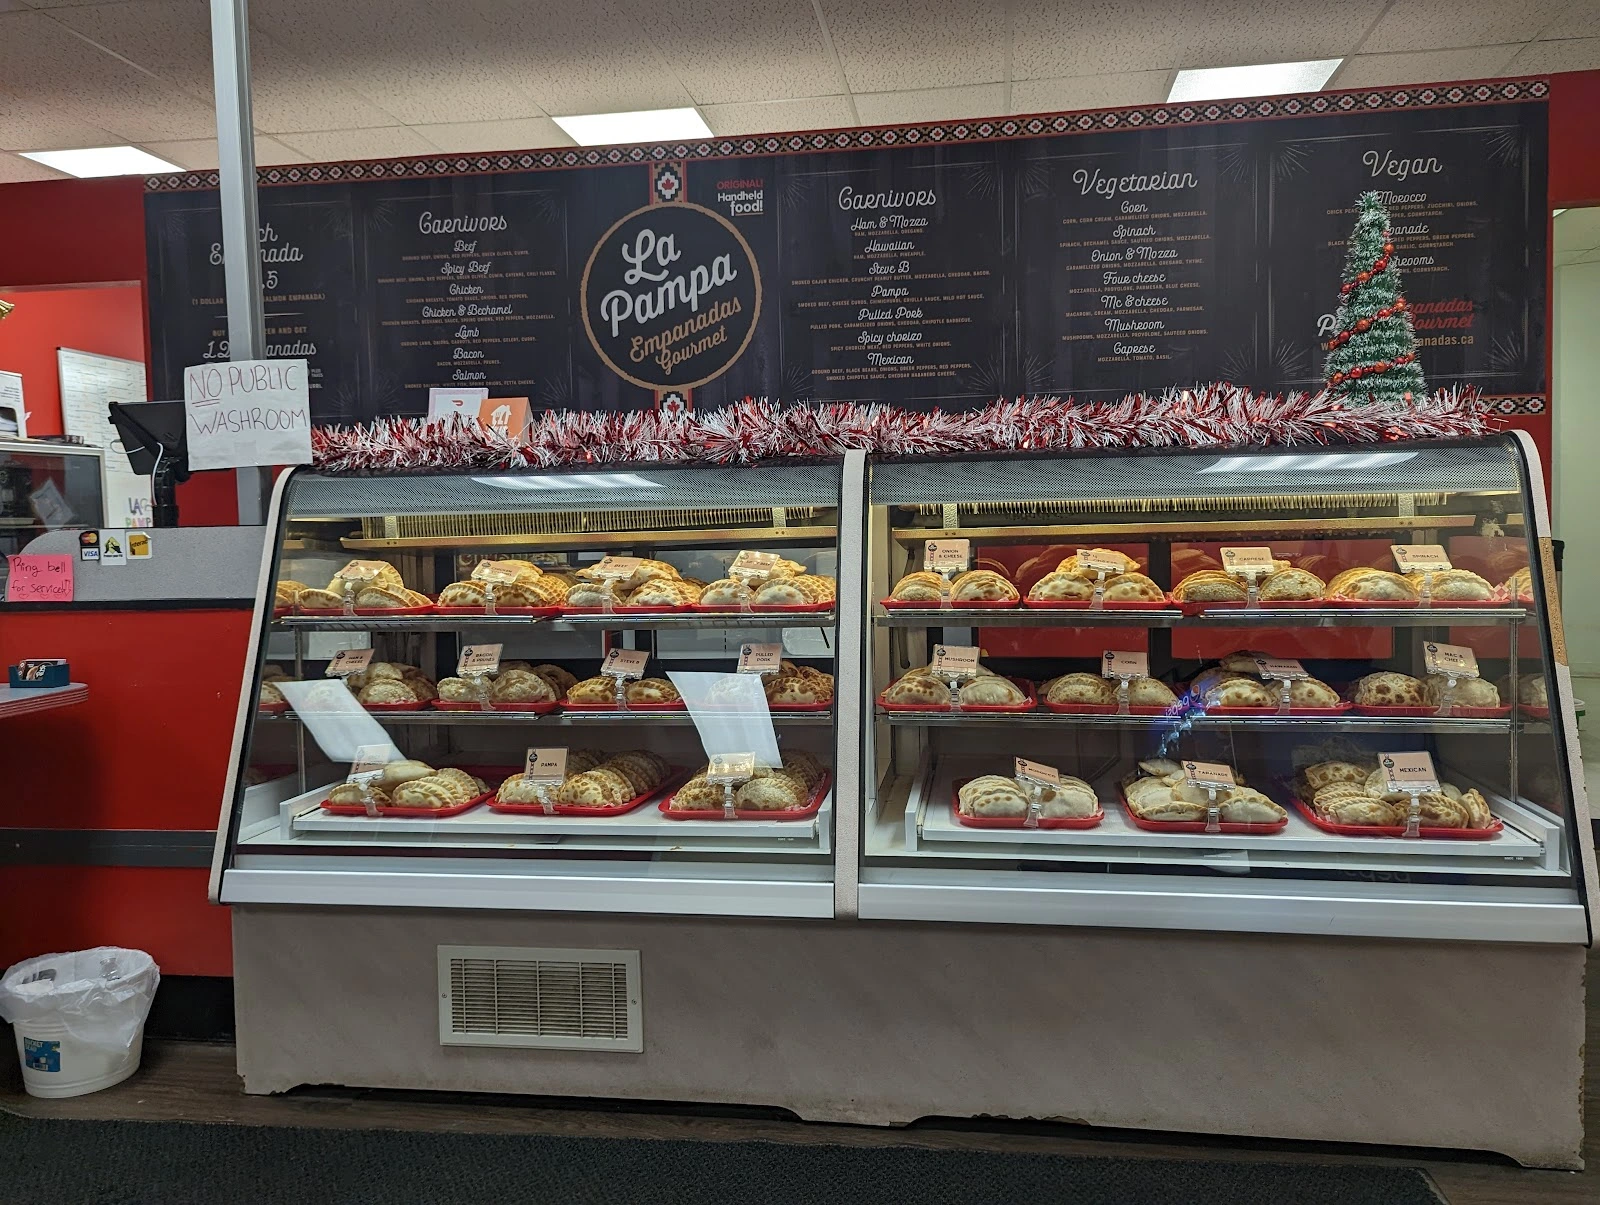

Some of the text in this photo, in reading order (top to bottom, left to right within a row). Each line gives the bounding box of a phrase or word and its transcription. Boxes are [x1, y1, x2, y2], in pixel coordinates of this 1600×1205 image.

[1363, 150, 1442, 181] Vegan
[717, 179, 763, 190] ORIGINAL!
[1073, 168, 1197, 199] Vegetarian
[718, 190, 763, 202] Handheld
[839, 186, 936, 210] Carnivors
[1377, 191, 1426, 205] Morocco
[730, 200, 763, 216] food!
[1121, 201, 1148, 213] Corn
[419, 212, 508, 234] Carnivors
[851, 215, 928, 231] Ham & Mozza
[1113, 225, 1156, 240] Spinach
[454, 240, 478, 253] Beef
[865, 240, 915, 253] Hawaiian
[622, 229, 681, 284] La
[1092, 246, 1178, 262] Onion & Mozza
[441, 261, 491, 276] Spicy Beef
[869, 261, 909, 275] Steve B
[1103, 271, 1166, 285] Four cheese
[449, 284, 484, 296] Chicken
[600, 254, 737, 337] Pampa
[871, 285, 909, 298] Pampa
[1101, 295, 1168, 309] Mc & cheese
[422, 304, 513, 318] Chicken & Bechamel
[858, 306, 923, 321] Pulled Pork
[455, 325, 479, 339] Lamb
[630, 297, 741, 362] Empanadas
[1105, 318, 1164, 332] Mushroom
[858, 331, 922, 345] Spicy chorizo
[453, 348, 484, 359] Bacon
[656, 325, 728, 375] Gourmet
[1114, 342, 1155, 356] Caprese
[867, 353, 914, 366] Mexican
[452, 369, 486, 380] Salmon
[190, 365, 298, 400] NO PUBLIC
[189, 408, 307, 434] WASHROOM
[13, 557, 66, 577] Ring bell
[11, 580, 25, 592] for
